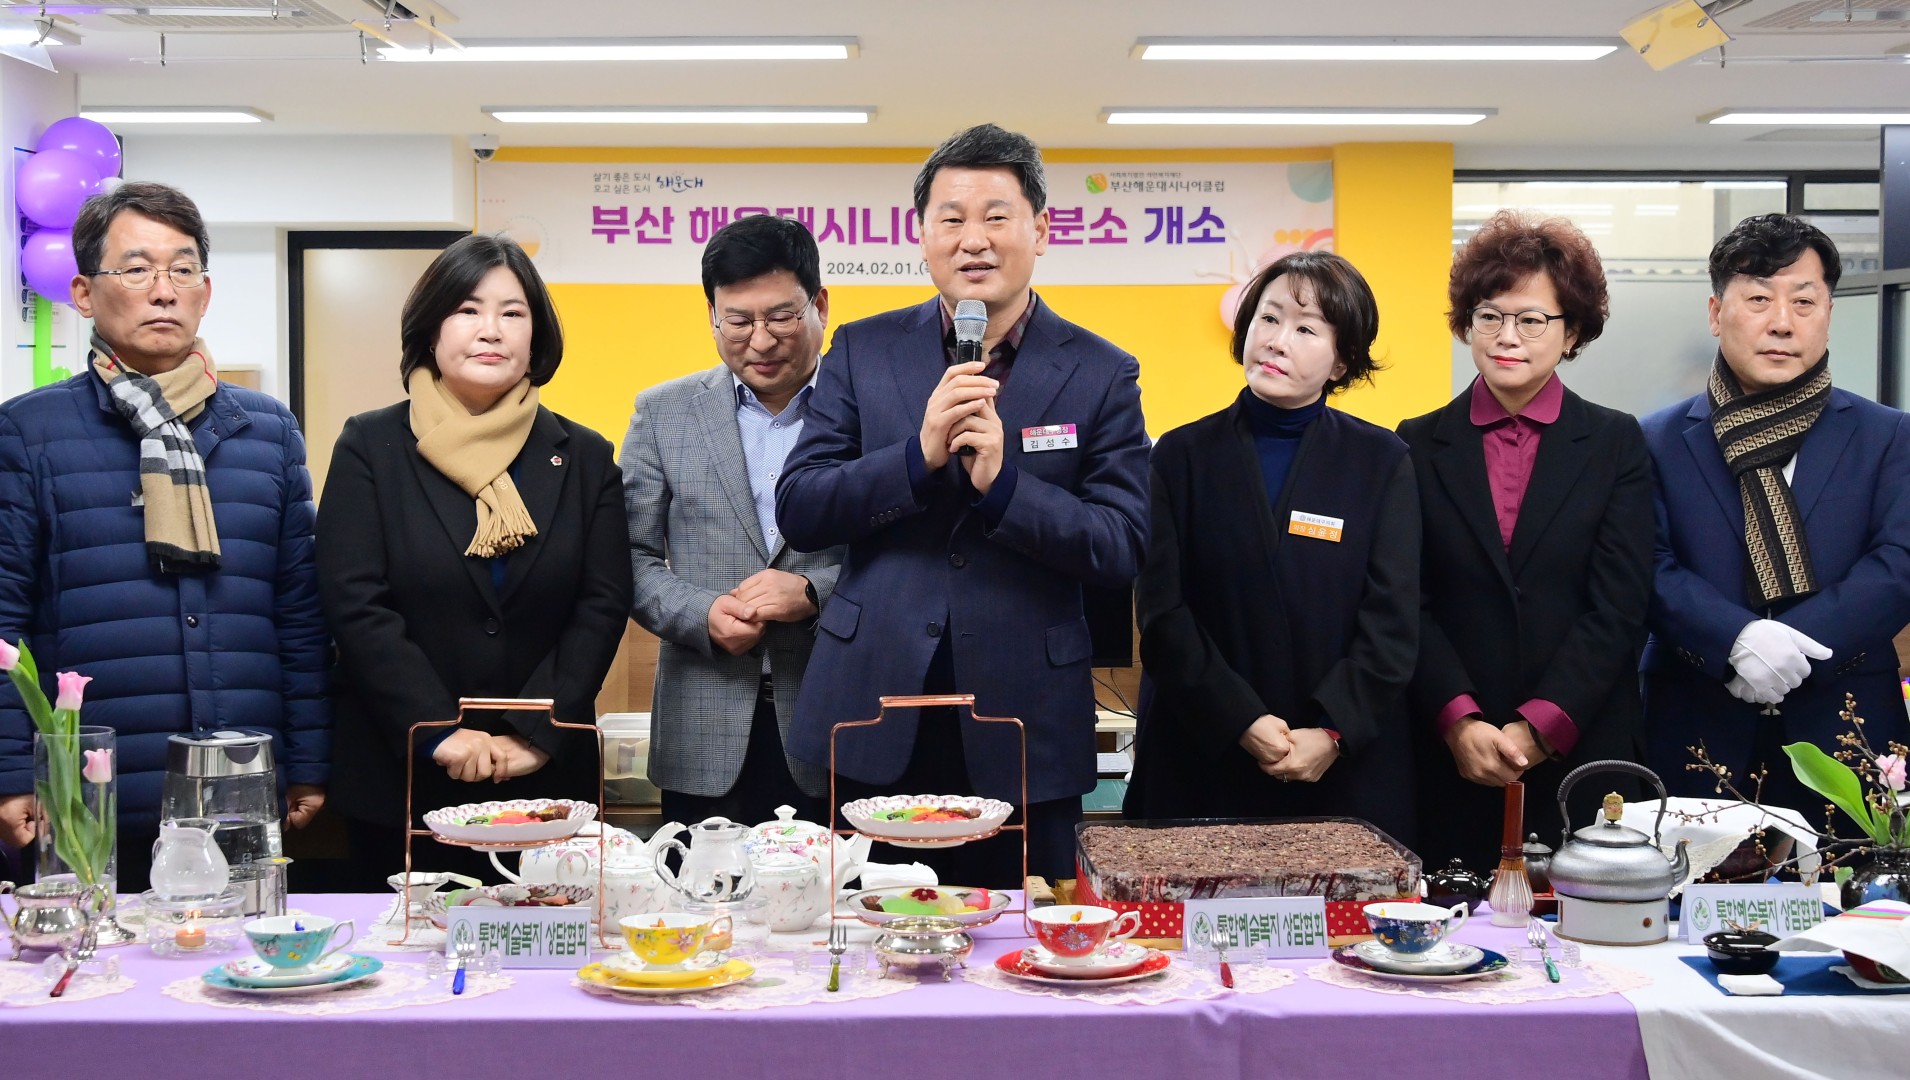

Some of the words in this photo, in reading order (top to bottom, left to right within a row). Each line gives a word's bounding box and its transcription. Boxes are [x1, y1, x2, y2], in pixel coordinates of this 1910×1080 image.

[593, 172, 611, 182] 살기
[614, 172, 631, 183] 좋은
[633, 172, 651, 182] 도시
[656, 175, 704, 193] 해운대
[633, 185, 651, 193] 도시
[1111, 181, 1225, 193] 부산해운대시니어클럽
[592, 206, 675, 244] 부산
[1048, 206, 1128, 245] 분소
[1144, 206, 1226, 244] 개소
[1030, 437, 1070, 449] 김성수
[1781, 898, 1822, 931] 상담협회
[1283, 912, 1325, 946] 상담협회
[479, 921, 542, 956] 통합예술복지
[546, 921, 587, 956] 상담협회
